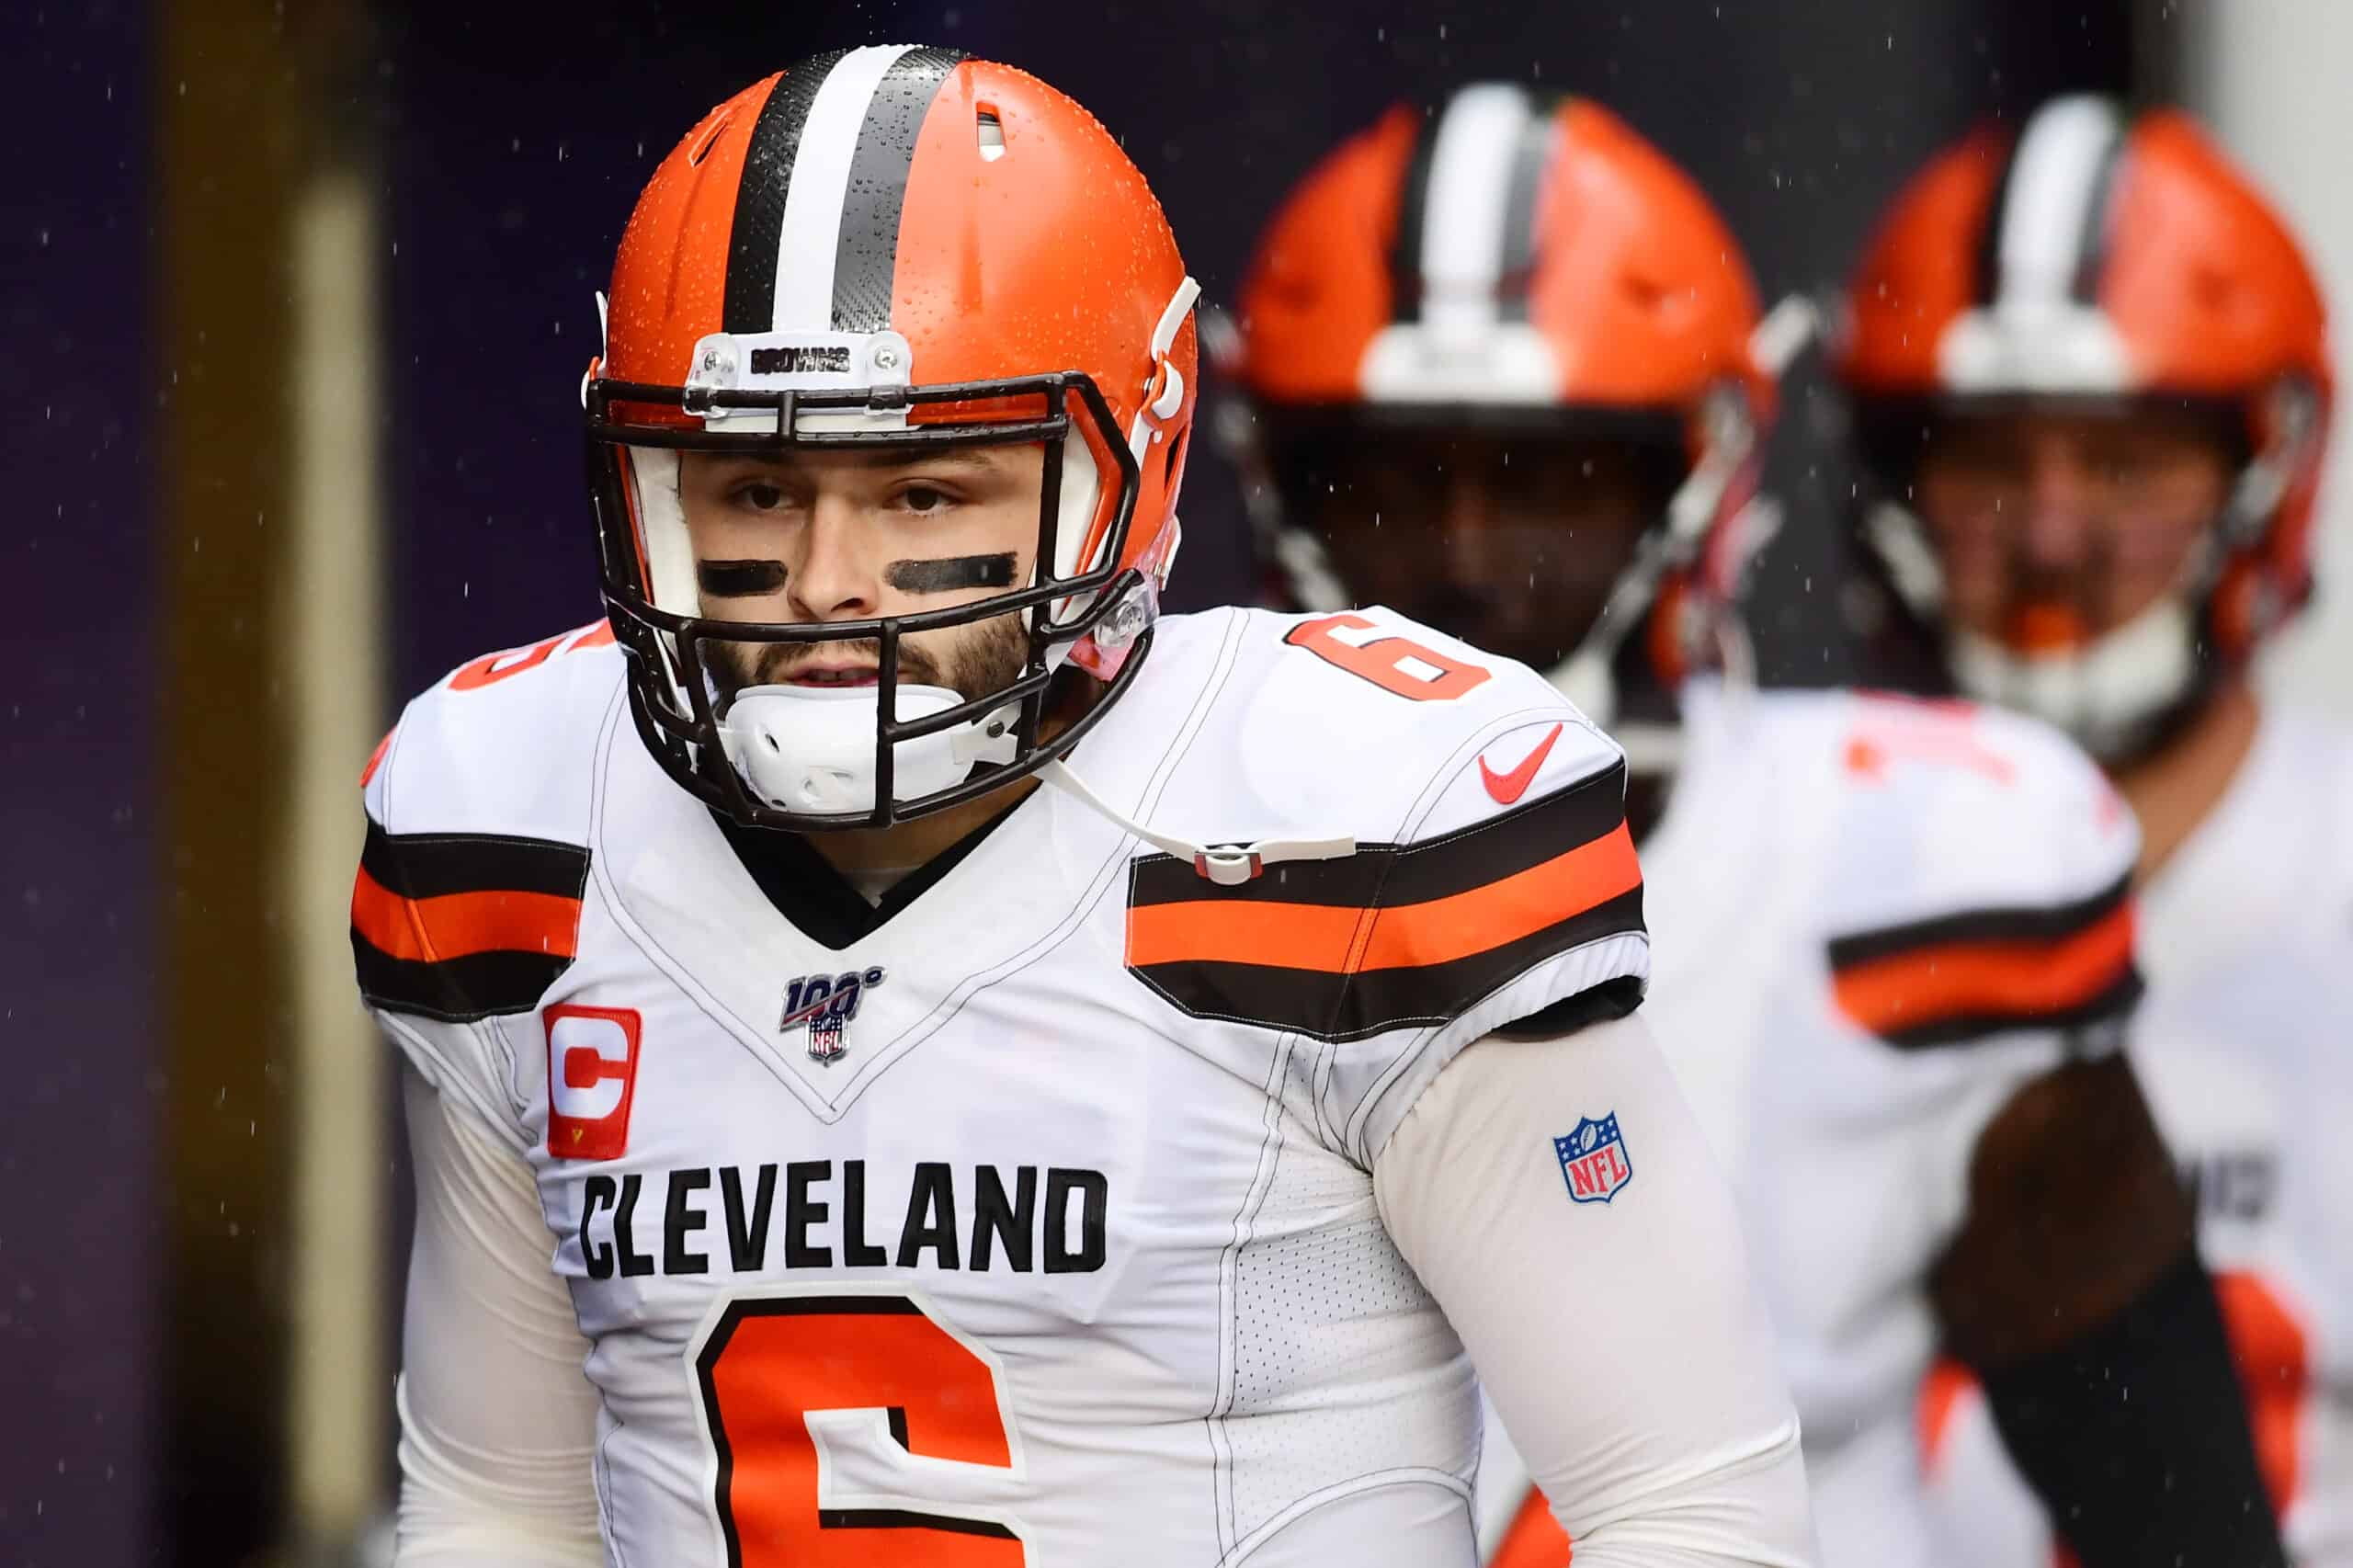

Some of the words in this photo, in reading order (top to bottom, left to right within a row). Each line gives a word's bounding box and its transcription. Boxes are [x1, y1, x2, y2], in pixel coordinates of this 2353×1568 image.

[750, 346, 851, 375] BROWNS
[1281, 615, 1493, 701] 6
[550, 1016, 629, 1119] C
[1568, 1146, 1627, 1196] NFL
[580, 1159, 1108, 1279] CLEVELAND
